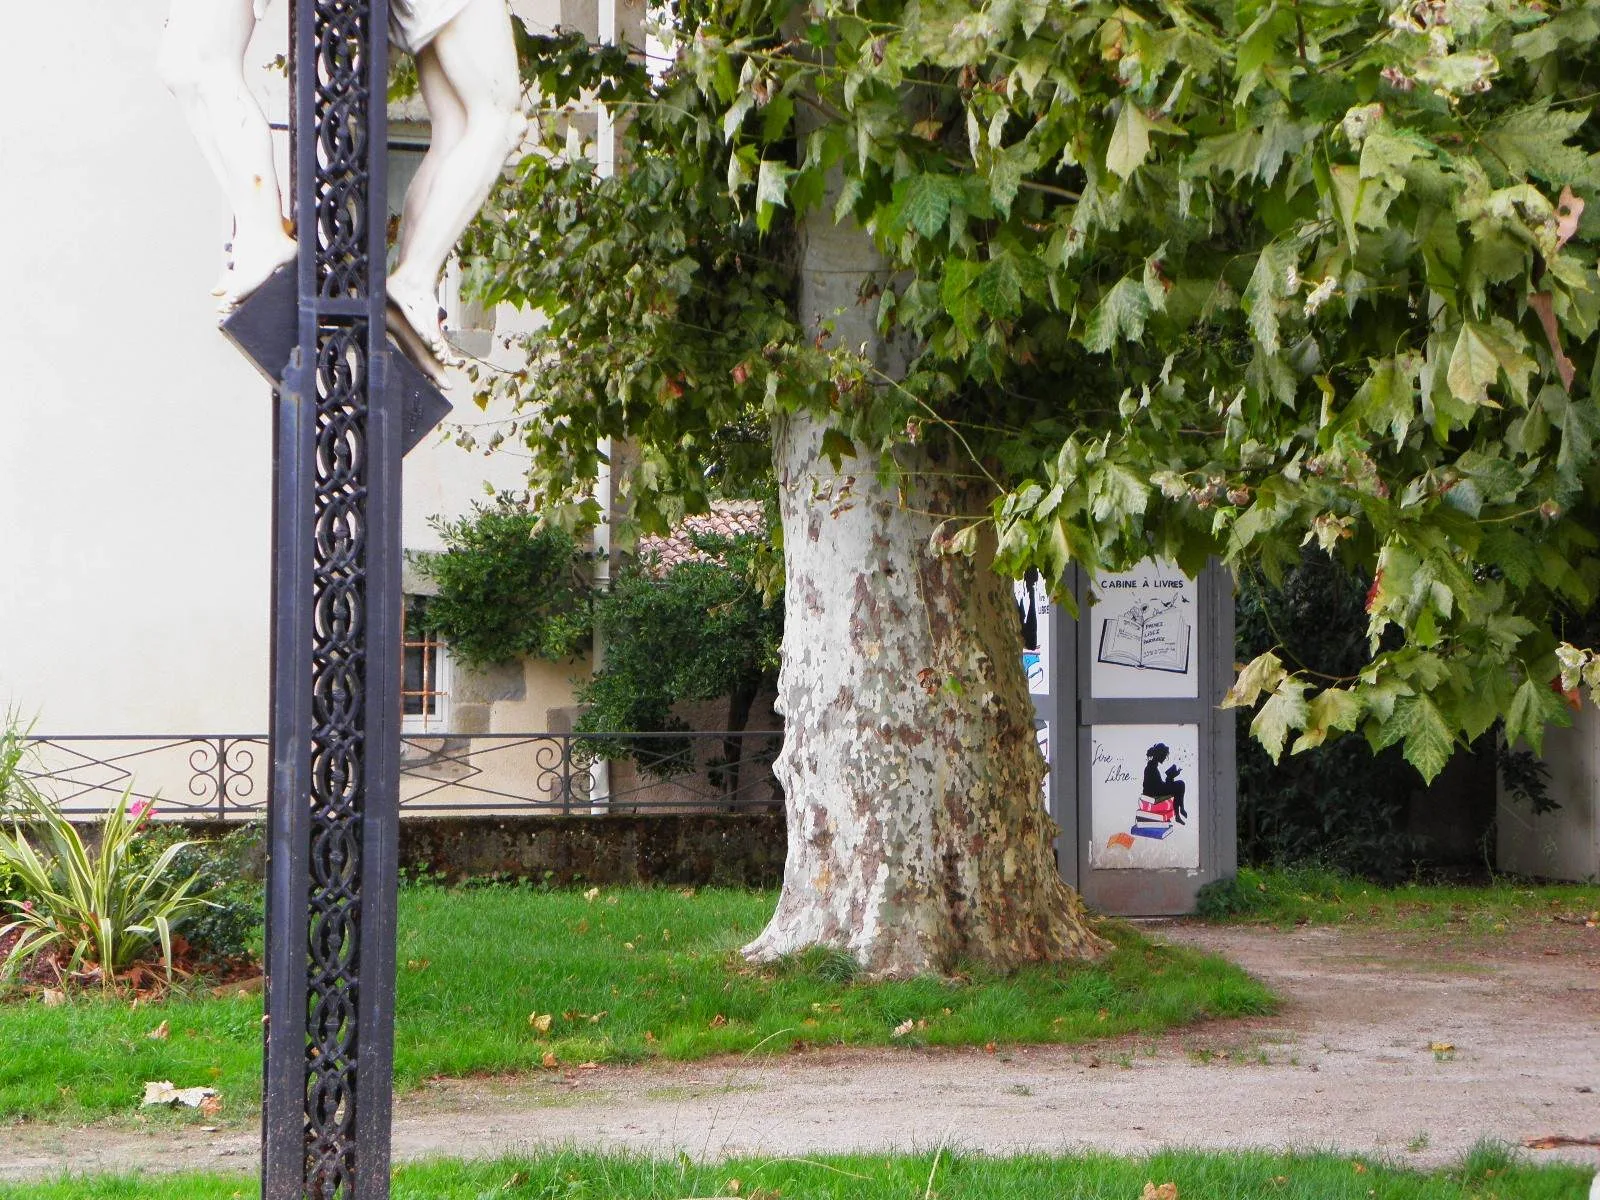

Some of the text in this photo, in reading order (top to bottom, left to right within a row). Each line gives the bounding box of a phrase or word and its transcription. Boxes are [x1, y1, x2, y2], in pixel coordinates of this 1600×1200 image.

[1101, 576, 1184, 589] CABINE À LIVRES
